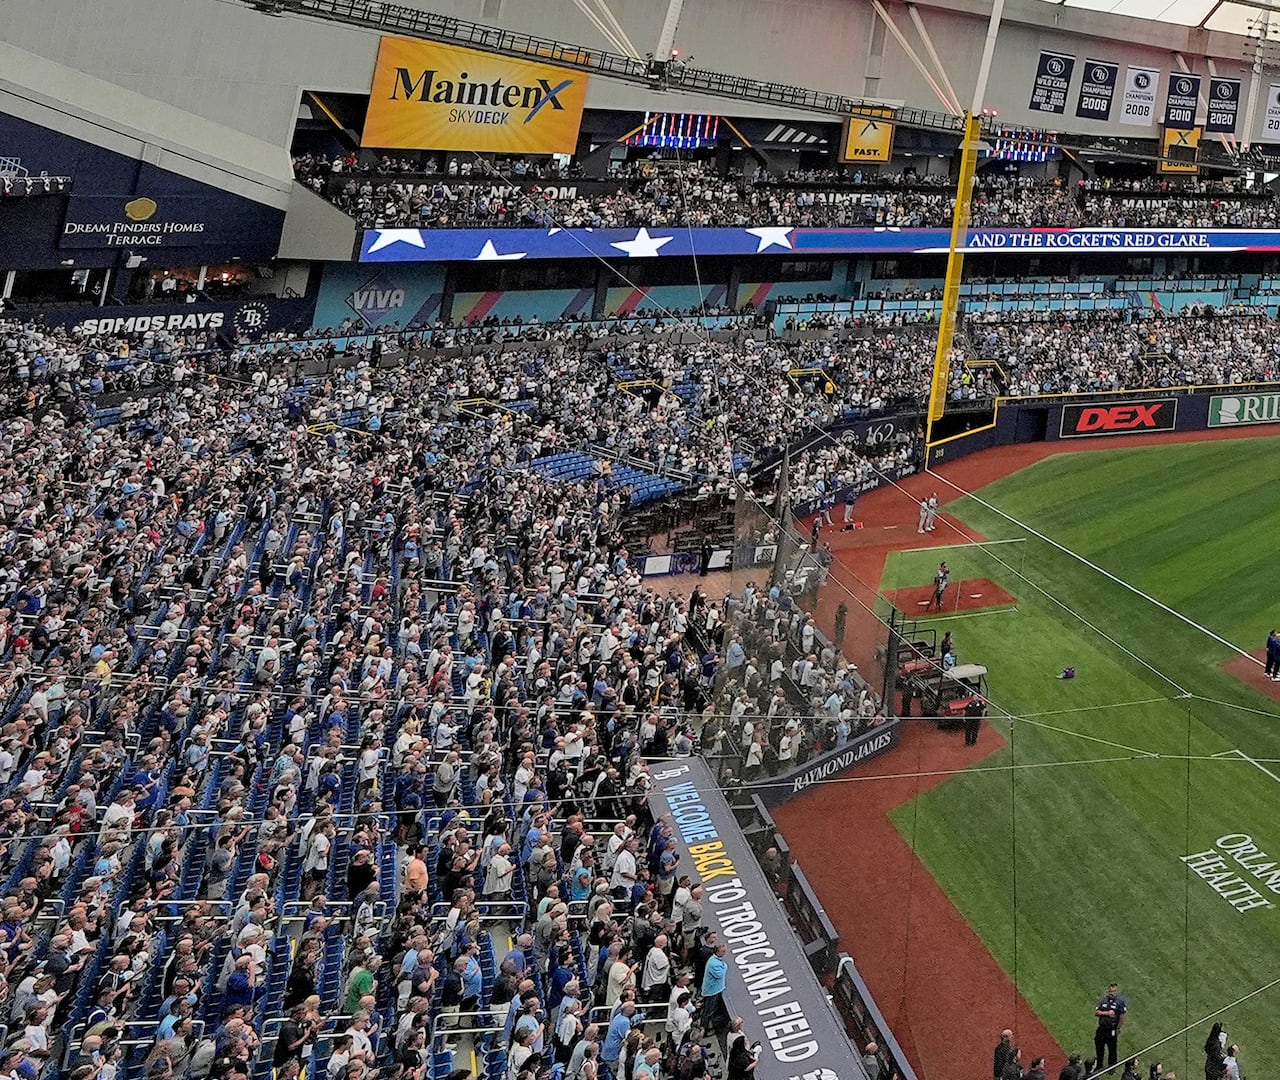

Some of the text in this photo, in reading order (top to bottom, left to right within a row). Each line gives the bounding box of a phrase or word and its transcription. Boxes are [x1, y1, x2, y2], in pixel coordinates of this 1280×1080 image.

[388, 67, 573, 124] MaintenX
[1082, 86, 1112, 96] CHAMPIONS
[1125, 92, 1154, 102] CHAMPIONS
[1082, 97, 1107, 111] 2008
[1168, 97, 1196, 107] CHAMPIONS
[1209, 102, 1237, 111] CHAMPIONS
[1126, 104, 1149, 116] 2008
[1169, 109, 1191, 121] 2010
[1210, 113, 1233, 124] 2020
[854, 148, 880, 156] FAST.
[64, 223, 204, 234] DREAM FINDERS HOMES
[106, 235, 162, 245] TERRACE
[970, 234, 1210, 248] AND THE ROCKET'S RED GLARE,
[353, 290, 405, 309] VIVA
[84, 313, 224, 335] SOMOS RAYS
[1075, 404, 1163, 431] DEX
[792, 731, 891, 793] RAYMOND JAMES
[1179, 849, 1270, 913] HEALTH
[663, 782, 819, 1063] WELCOME BACK TO TROPICANA FIELD
